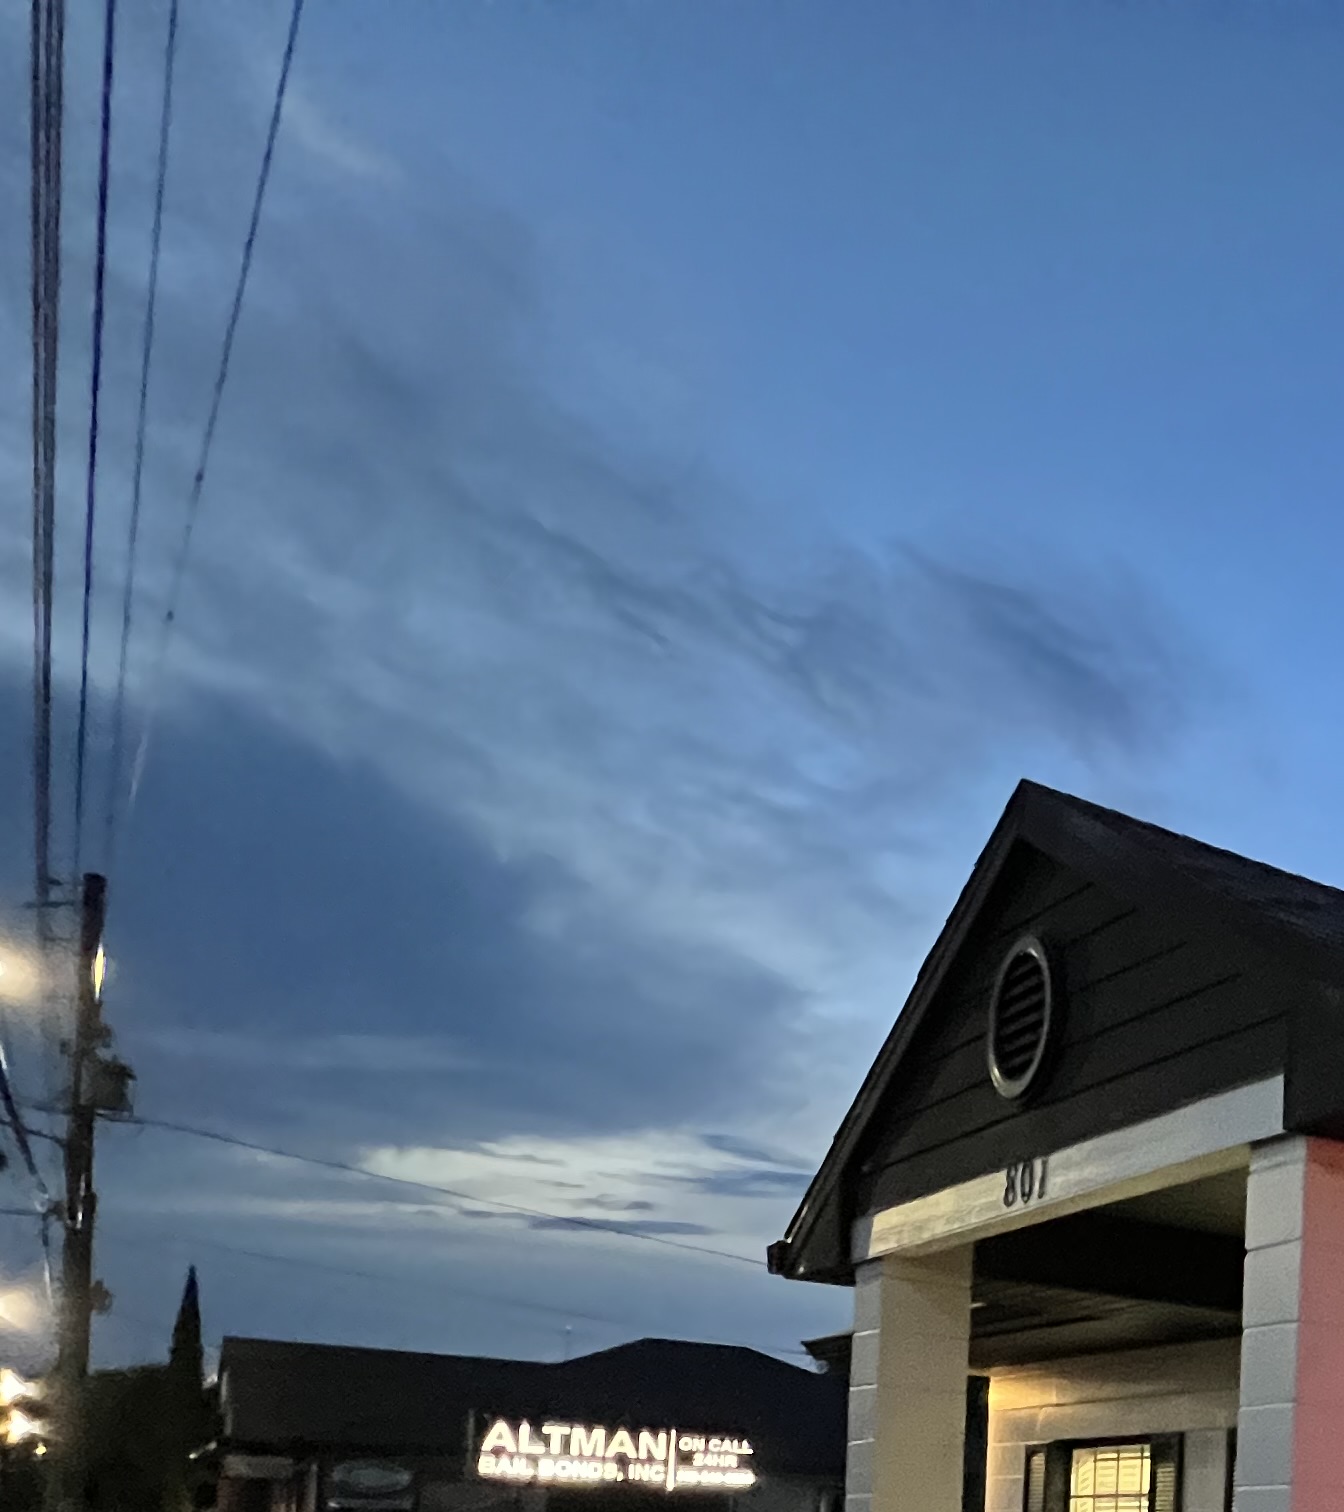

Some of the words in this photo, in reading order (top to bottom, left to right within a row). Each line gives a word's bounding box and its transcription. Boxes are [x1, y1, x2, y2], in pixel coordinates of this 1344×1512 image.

[481, 1419, 667, 1461] ALTMAN
[678, 1435, 706, 1452] ON
[708, 1438, 754, 1455] CALL
